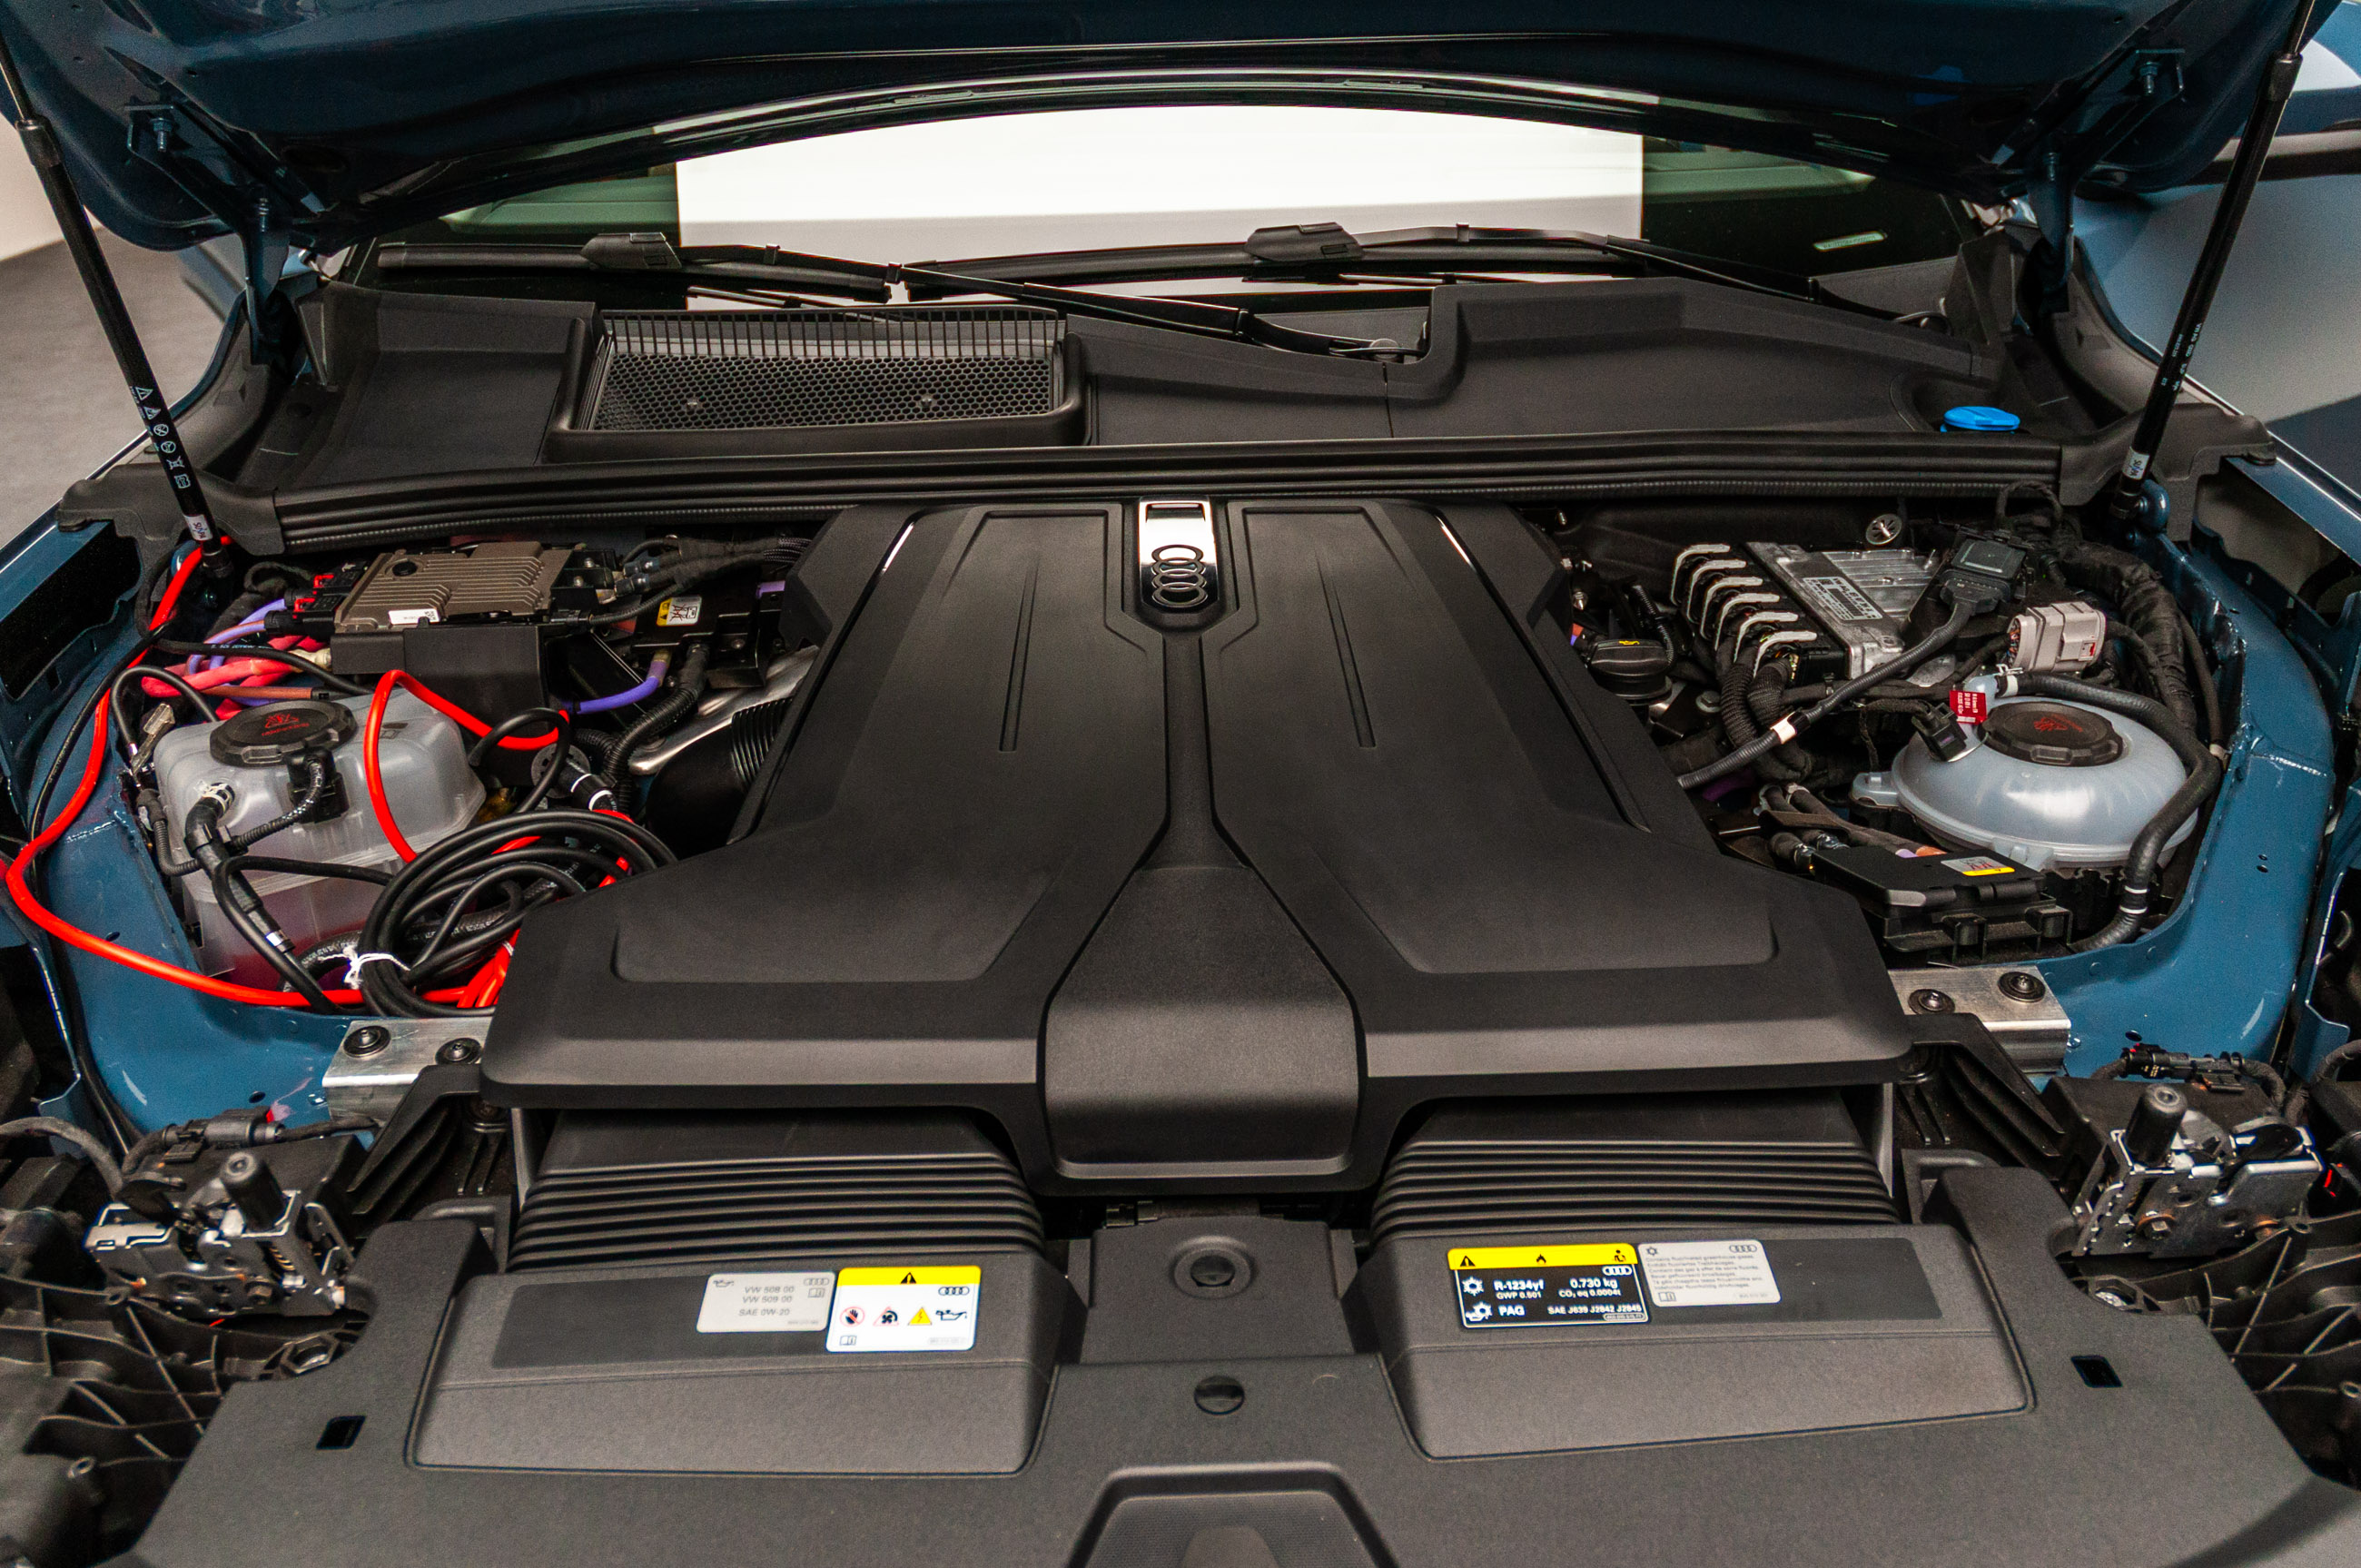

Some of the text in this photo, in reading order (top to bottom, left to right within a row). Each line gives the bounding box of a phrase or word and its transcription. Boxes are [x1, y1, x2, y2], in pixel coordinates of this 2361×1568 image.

[1494, 1278, 1545, 1291] R-1234yf
[1569, 1277, 1618, 1290] 0.730 kg
[763, 1286, 781, 1294] 508
[1578, 1290, 1589, 1298] eq
[742, 1296, 759, 1304] VW
[1496, 1292, 1518, 1300] GWP
[760, 1308, 790, 1317] 0W-20
[1498, 1306, 1526, 1317] PAG
[1547, 1306, 1566, 1315] SAE
